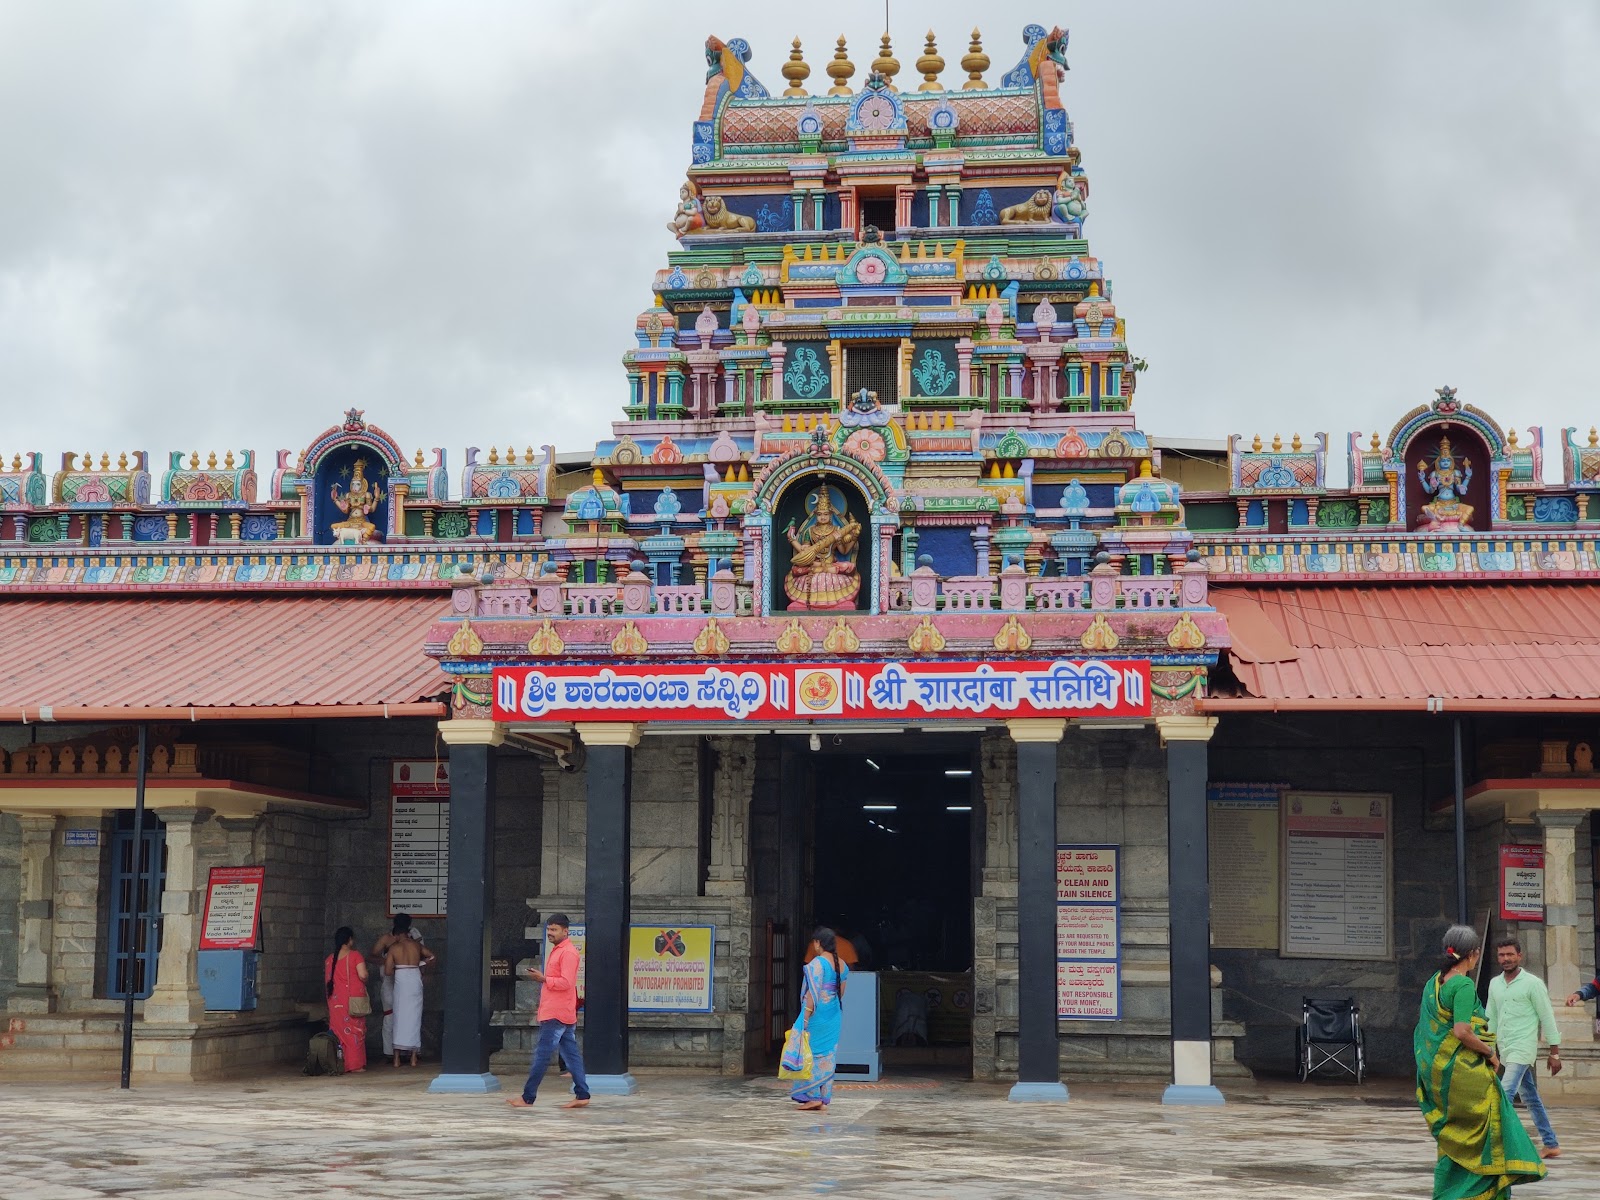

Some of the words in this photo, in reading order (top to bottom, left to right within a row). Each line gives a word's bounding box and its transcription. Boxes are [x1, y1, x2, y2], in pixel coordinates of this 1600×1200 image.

[526, 675, 557, 713] ಶ್ರೀ
[564, 674, 690, 703] ಶಾರದಾಂಬಾ
[696, 672, 760, 712] ಸನ್ನಿಧಿ
[872, 669, 907, 705] श्री
[914, 668, 1017, 706] शारदांबा
[1025, 665, 1120, 704] सन्निधि
[633, 977, 672, 990] PHOTOGRAPHY
[673, 977, 704, 990] PROHIBITED
[1080, 999, 1101, 1007] MONEY,
